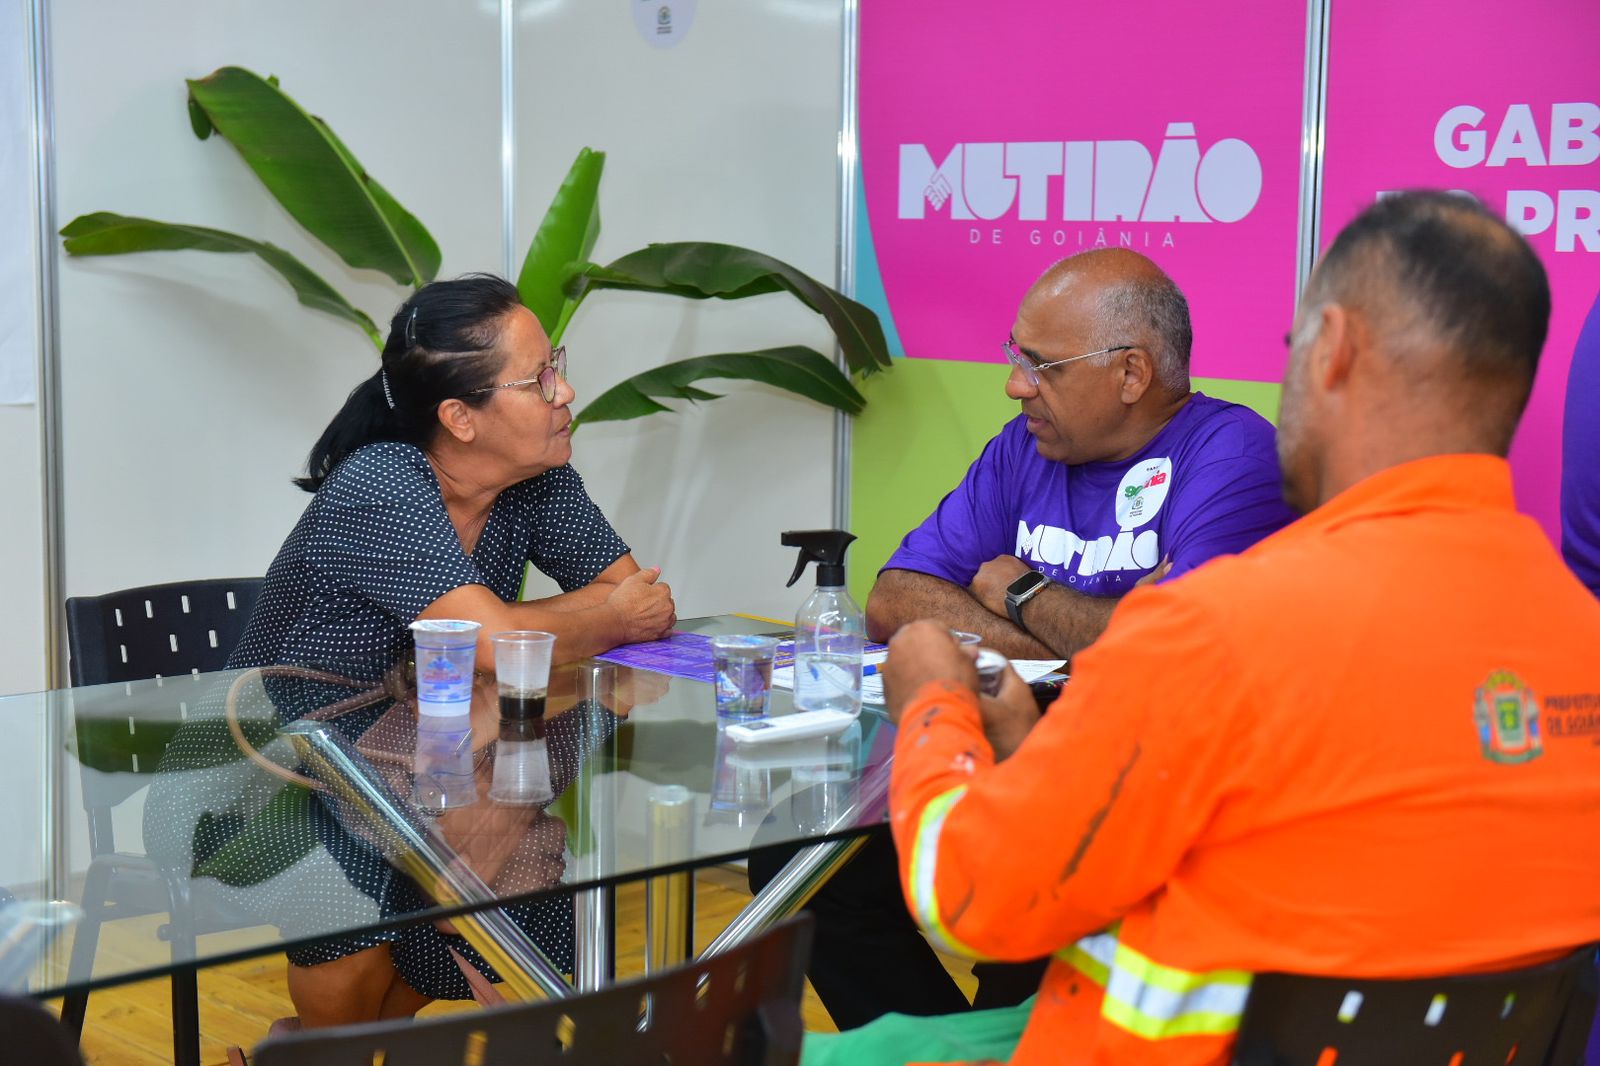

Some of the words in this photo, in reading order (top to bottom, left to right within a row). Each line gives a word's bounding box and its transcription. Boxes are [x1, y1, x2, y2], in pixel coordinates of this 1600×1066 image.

[1434, 102, 1600, 169] GAB
[897, 122, 1263, 223] MUTIRÃO
[969, 228, 1002, 245] DE
[1029, 227, 1175, 248] GOIÂNIA
